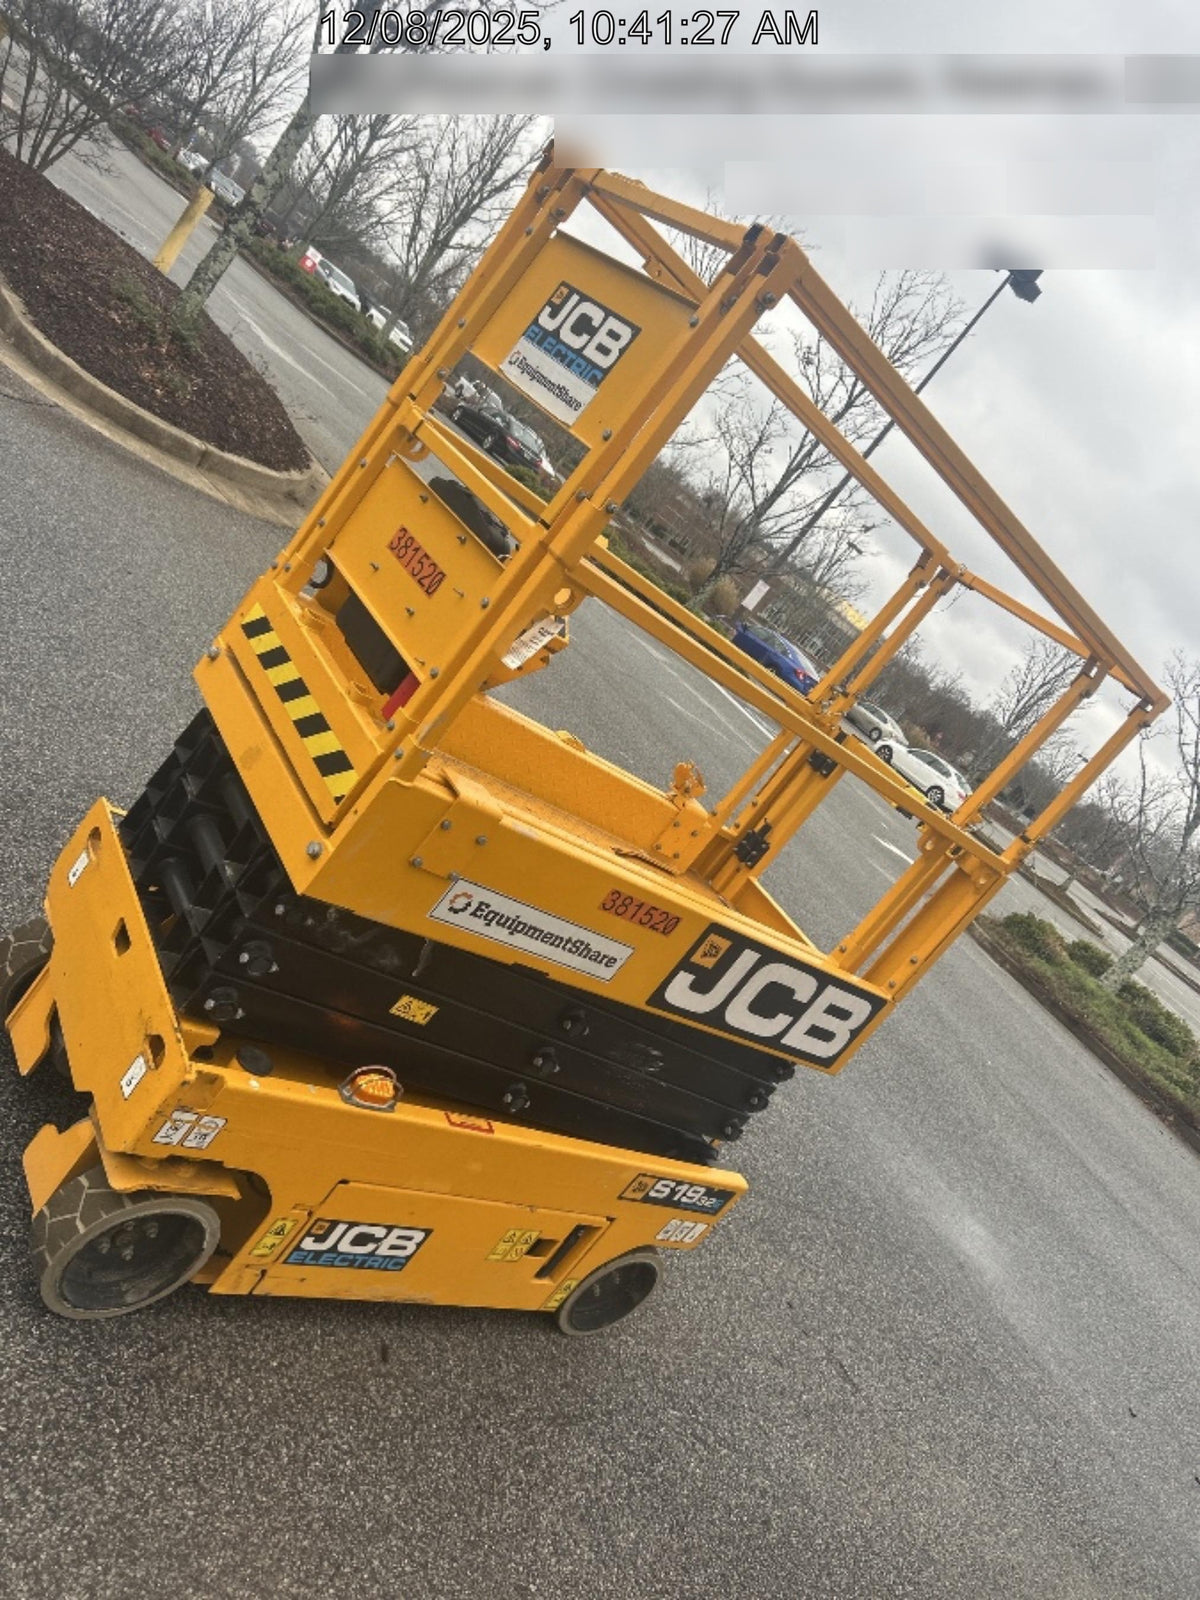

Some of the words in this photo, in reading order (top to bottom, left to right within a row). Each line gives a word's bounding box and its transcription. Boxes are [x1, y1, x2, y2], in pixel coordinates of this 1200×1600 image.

[538, 292, 632, 369] JCB
[517, 356, 583, 411] EquipmentShare
[389, 528, 446, 595] 381520
[470, 900, 618, 969] EquipmentShare
[602, 889, 682, 934] 381520
[665, 949, 873, 1058] JCB
[287, 1251, 407, 1270] ELECTRIC
[300, 1222, 426, 1257] JCB
